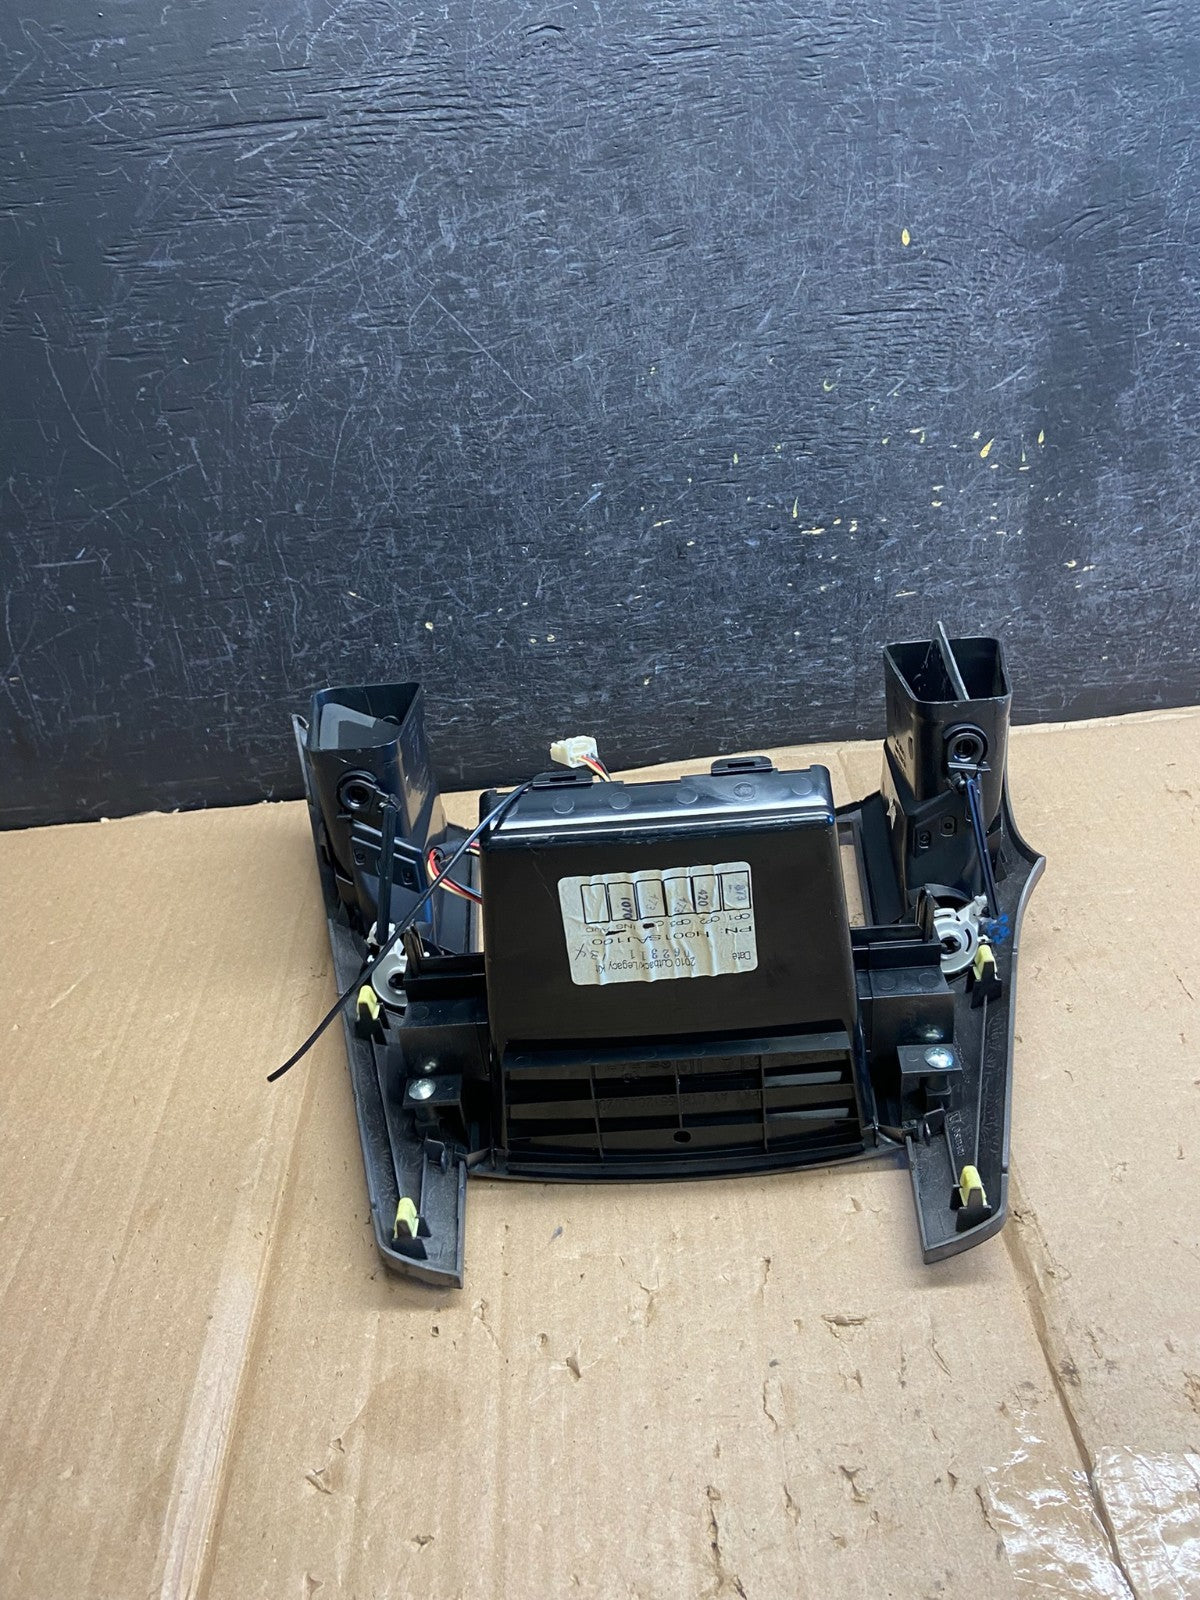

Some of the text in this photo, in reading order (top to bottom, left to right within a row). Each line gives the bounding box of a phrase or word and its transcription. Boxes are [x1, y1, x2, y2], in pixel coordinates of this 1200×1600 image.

[697, 889, 708, 907] 420
[719, 925, 752, 935] PN:
[674, 956, 696, 967] 2010
